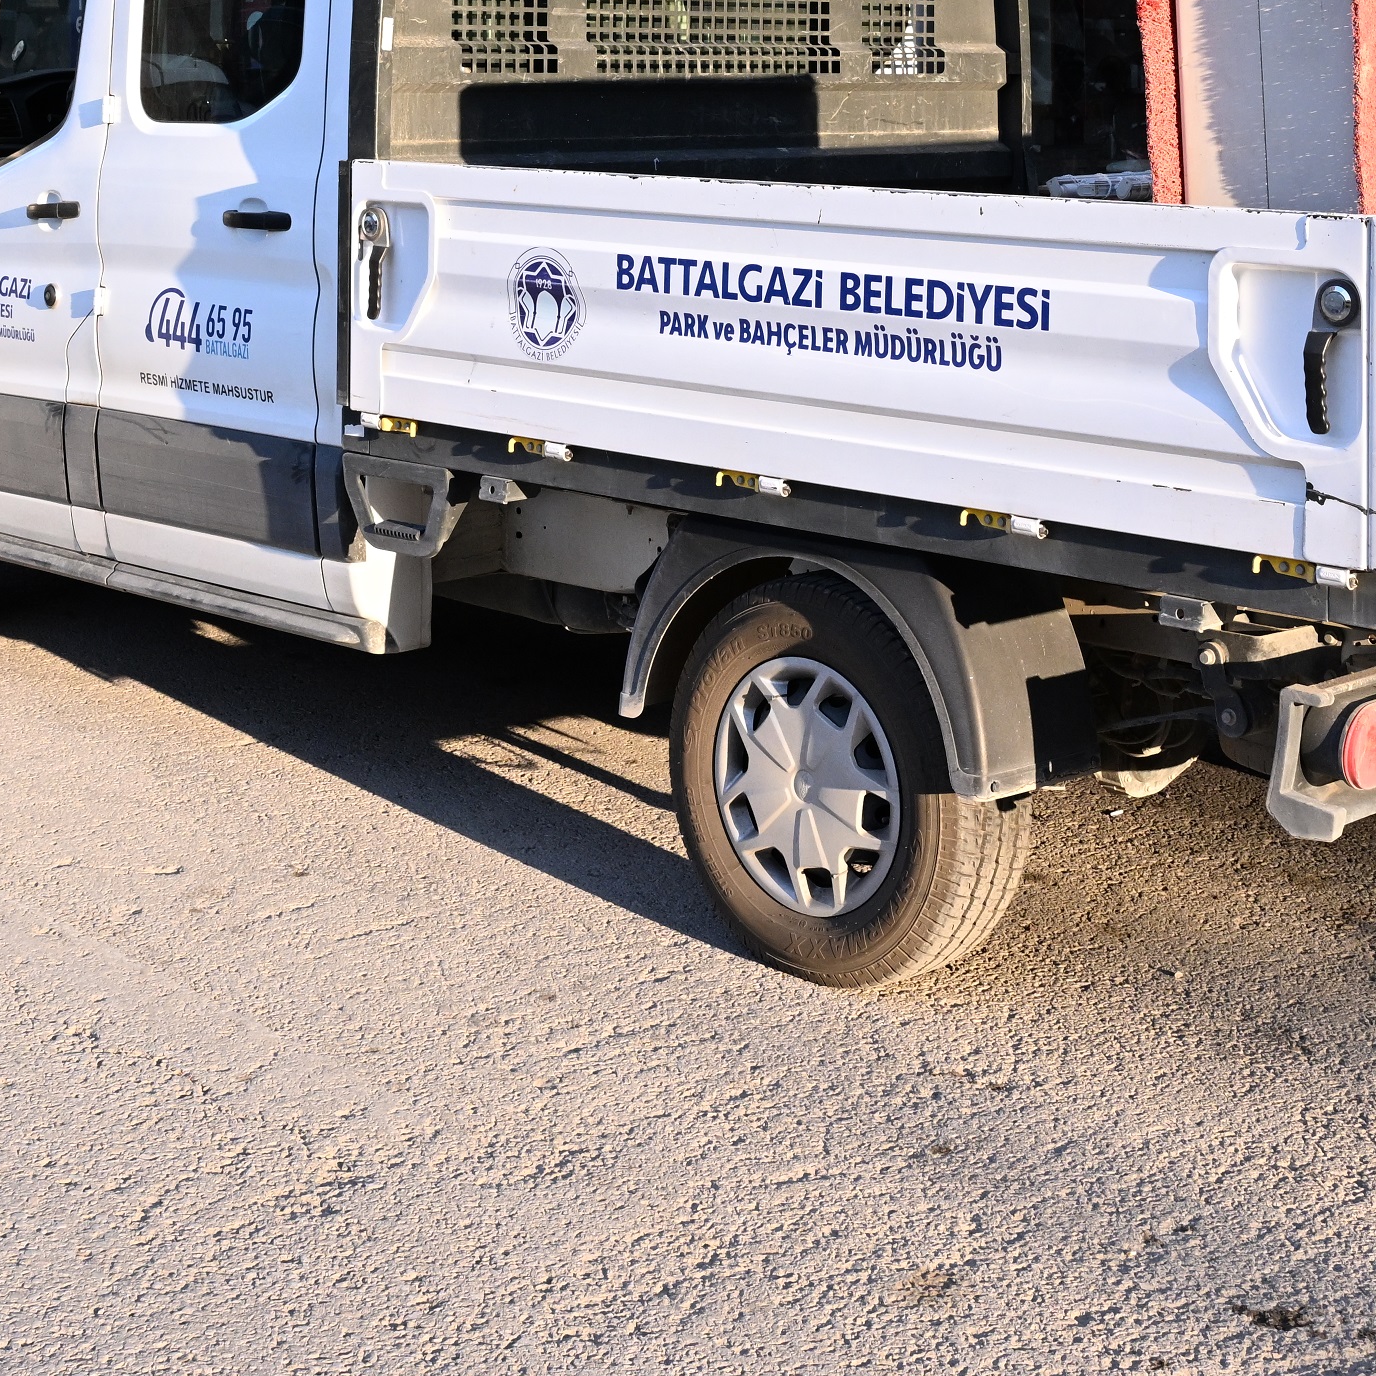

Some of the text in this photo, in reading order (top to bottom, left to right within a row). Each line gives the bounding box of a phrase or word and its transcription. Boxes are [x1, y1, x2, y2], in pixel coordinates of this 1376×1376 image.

[535, 279, 552, 289] 1928
[157, 297, 253, 352] 444 65 95
[659, 311, 1003, 372] PARK ve BAHÇELER MÜDÜRLÜĞÜ
[140, 372, 168, 387] RESMİ
[212, 382, 274, 403] MAHSUSTUR
